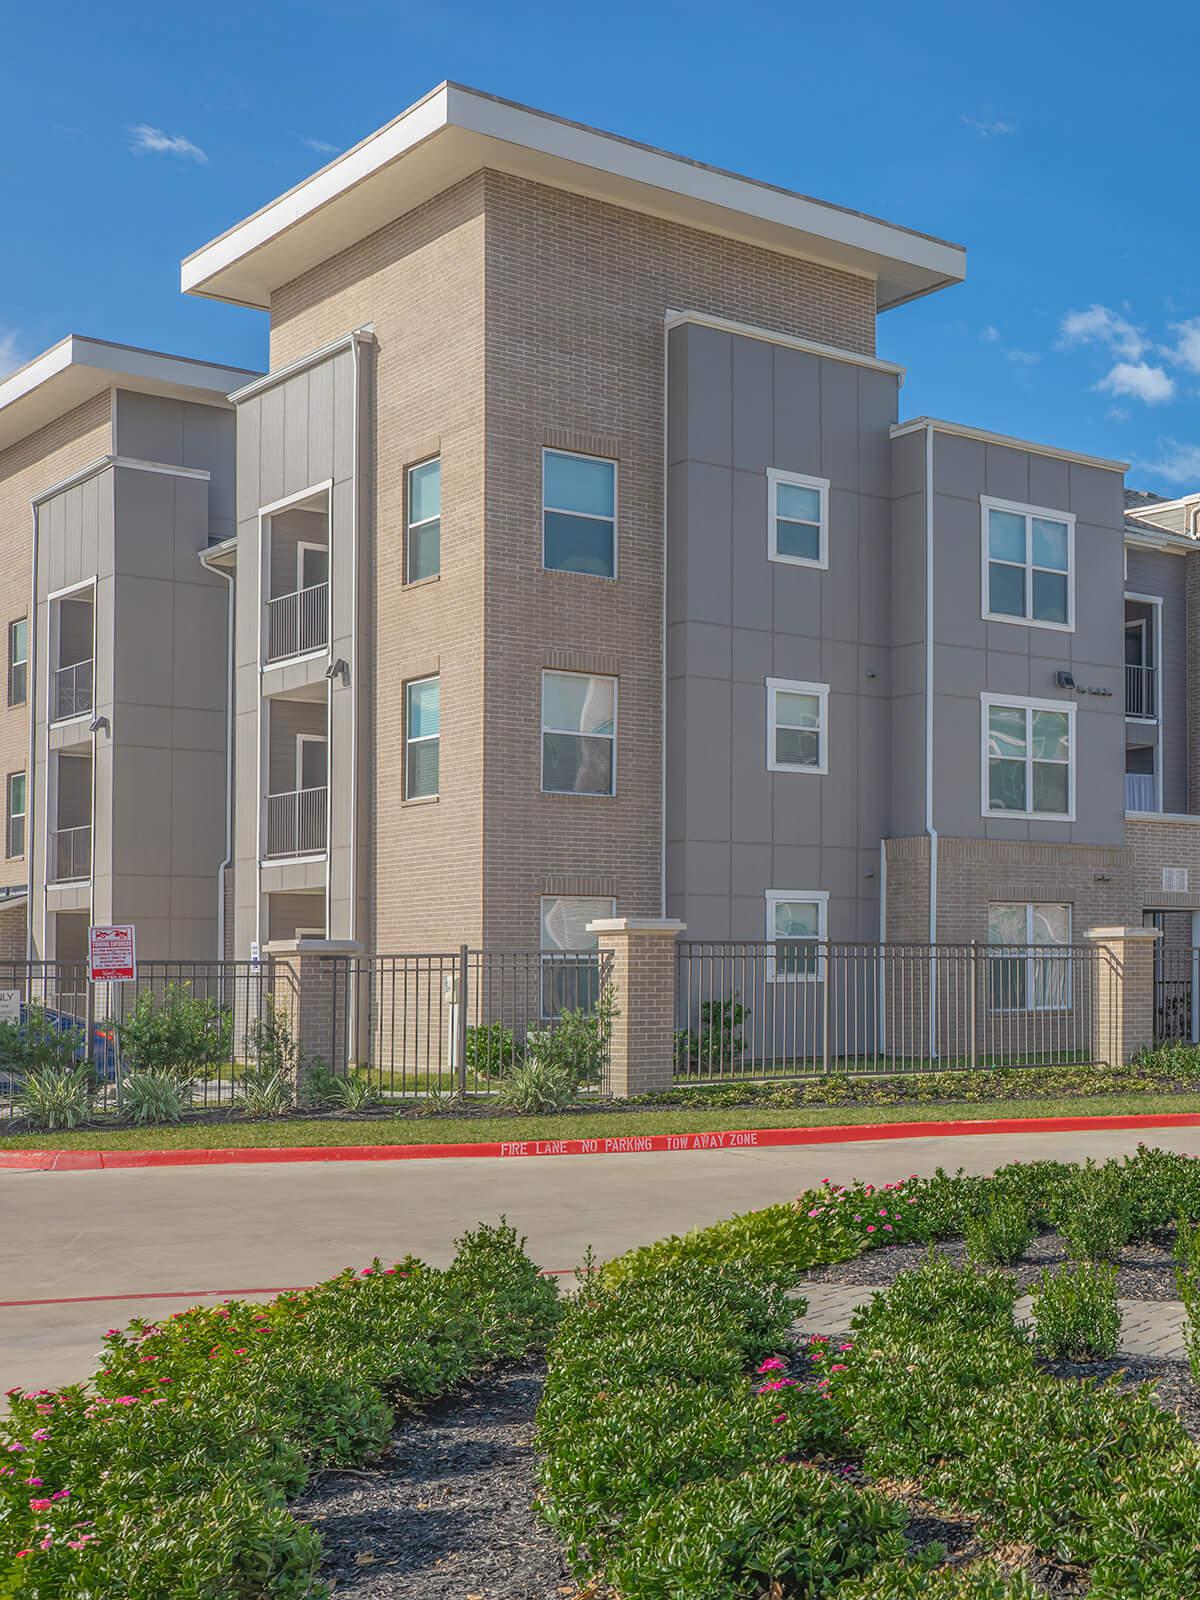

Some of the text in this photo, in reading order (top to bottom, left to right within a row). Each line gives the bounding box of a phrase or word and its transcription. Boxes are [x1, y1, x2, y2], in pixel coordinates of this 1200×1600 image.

[501, 1133, 759, 1156] FIRE LANE NO PARKING TOW AWAY ZONE
